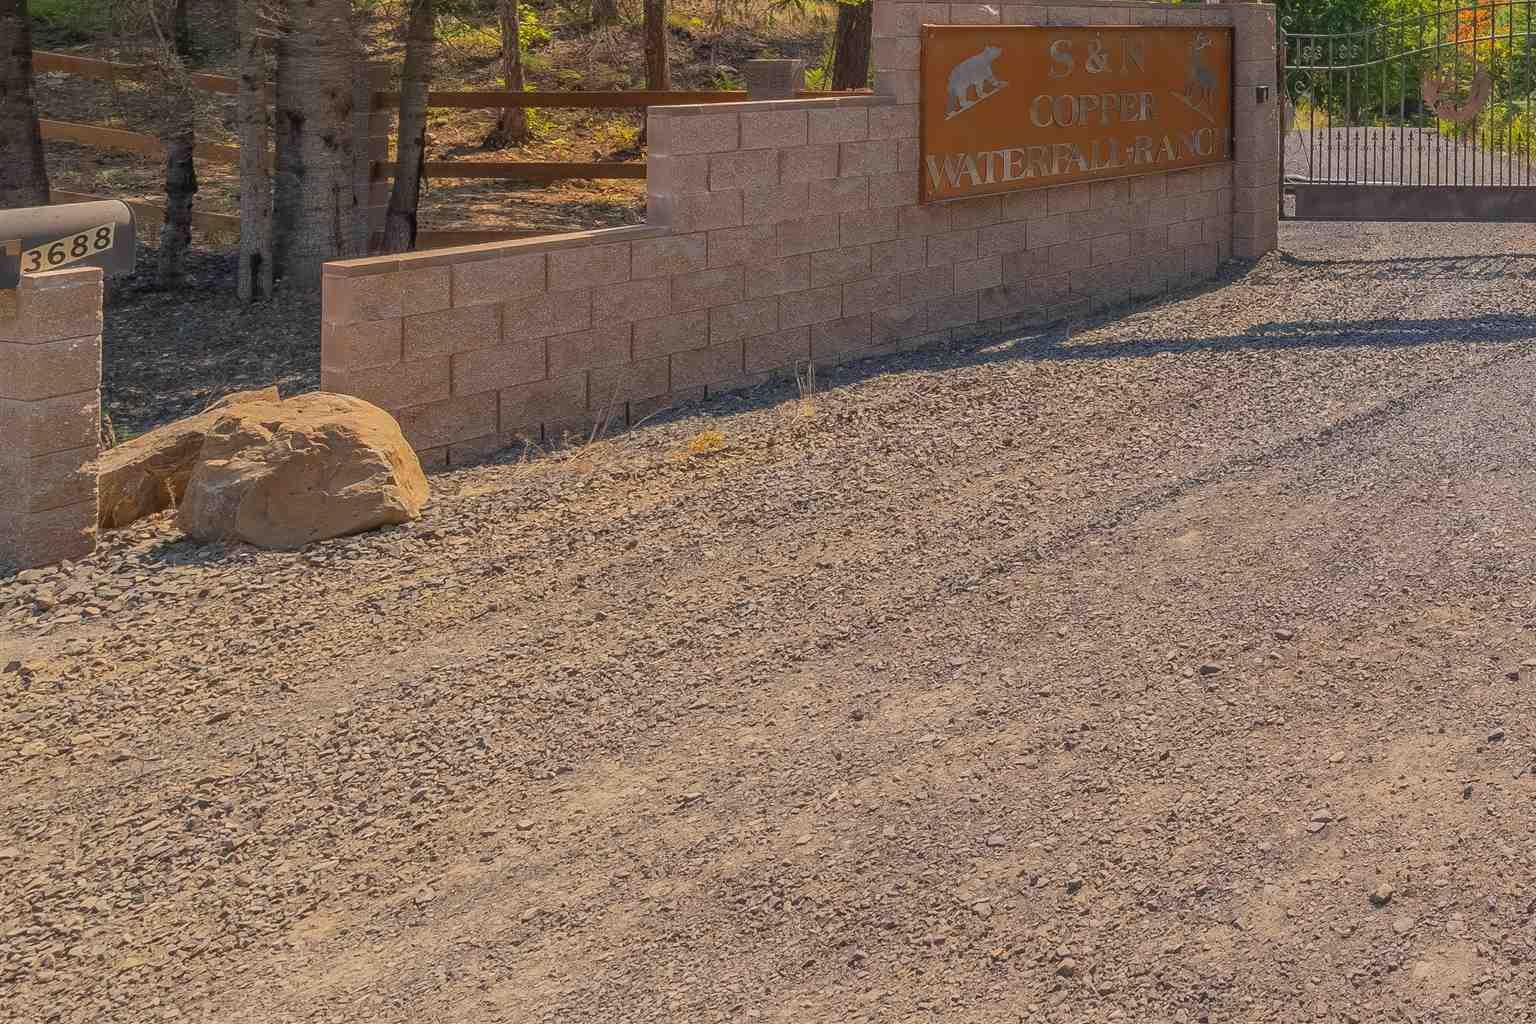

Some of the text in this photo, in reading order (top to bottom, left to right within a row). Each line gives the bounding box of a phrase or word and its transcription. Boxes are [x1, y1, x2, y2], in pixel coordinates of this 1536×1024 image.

[1049, 35, 1145, 77] S & N
[1030, 93, 1153, 127] COPPER
[926, 139, 1128, 193] WATERFALL
[23, 227, 111, 273] 3688
